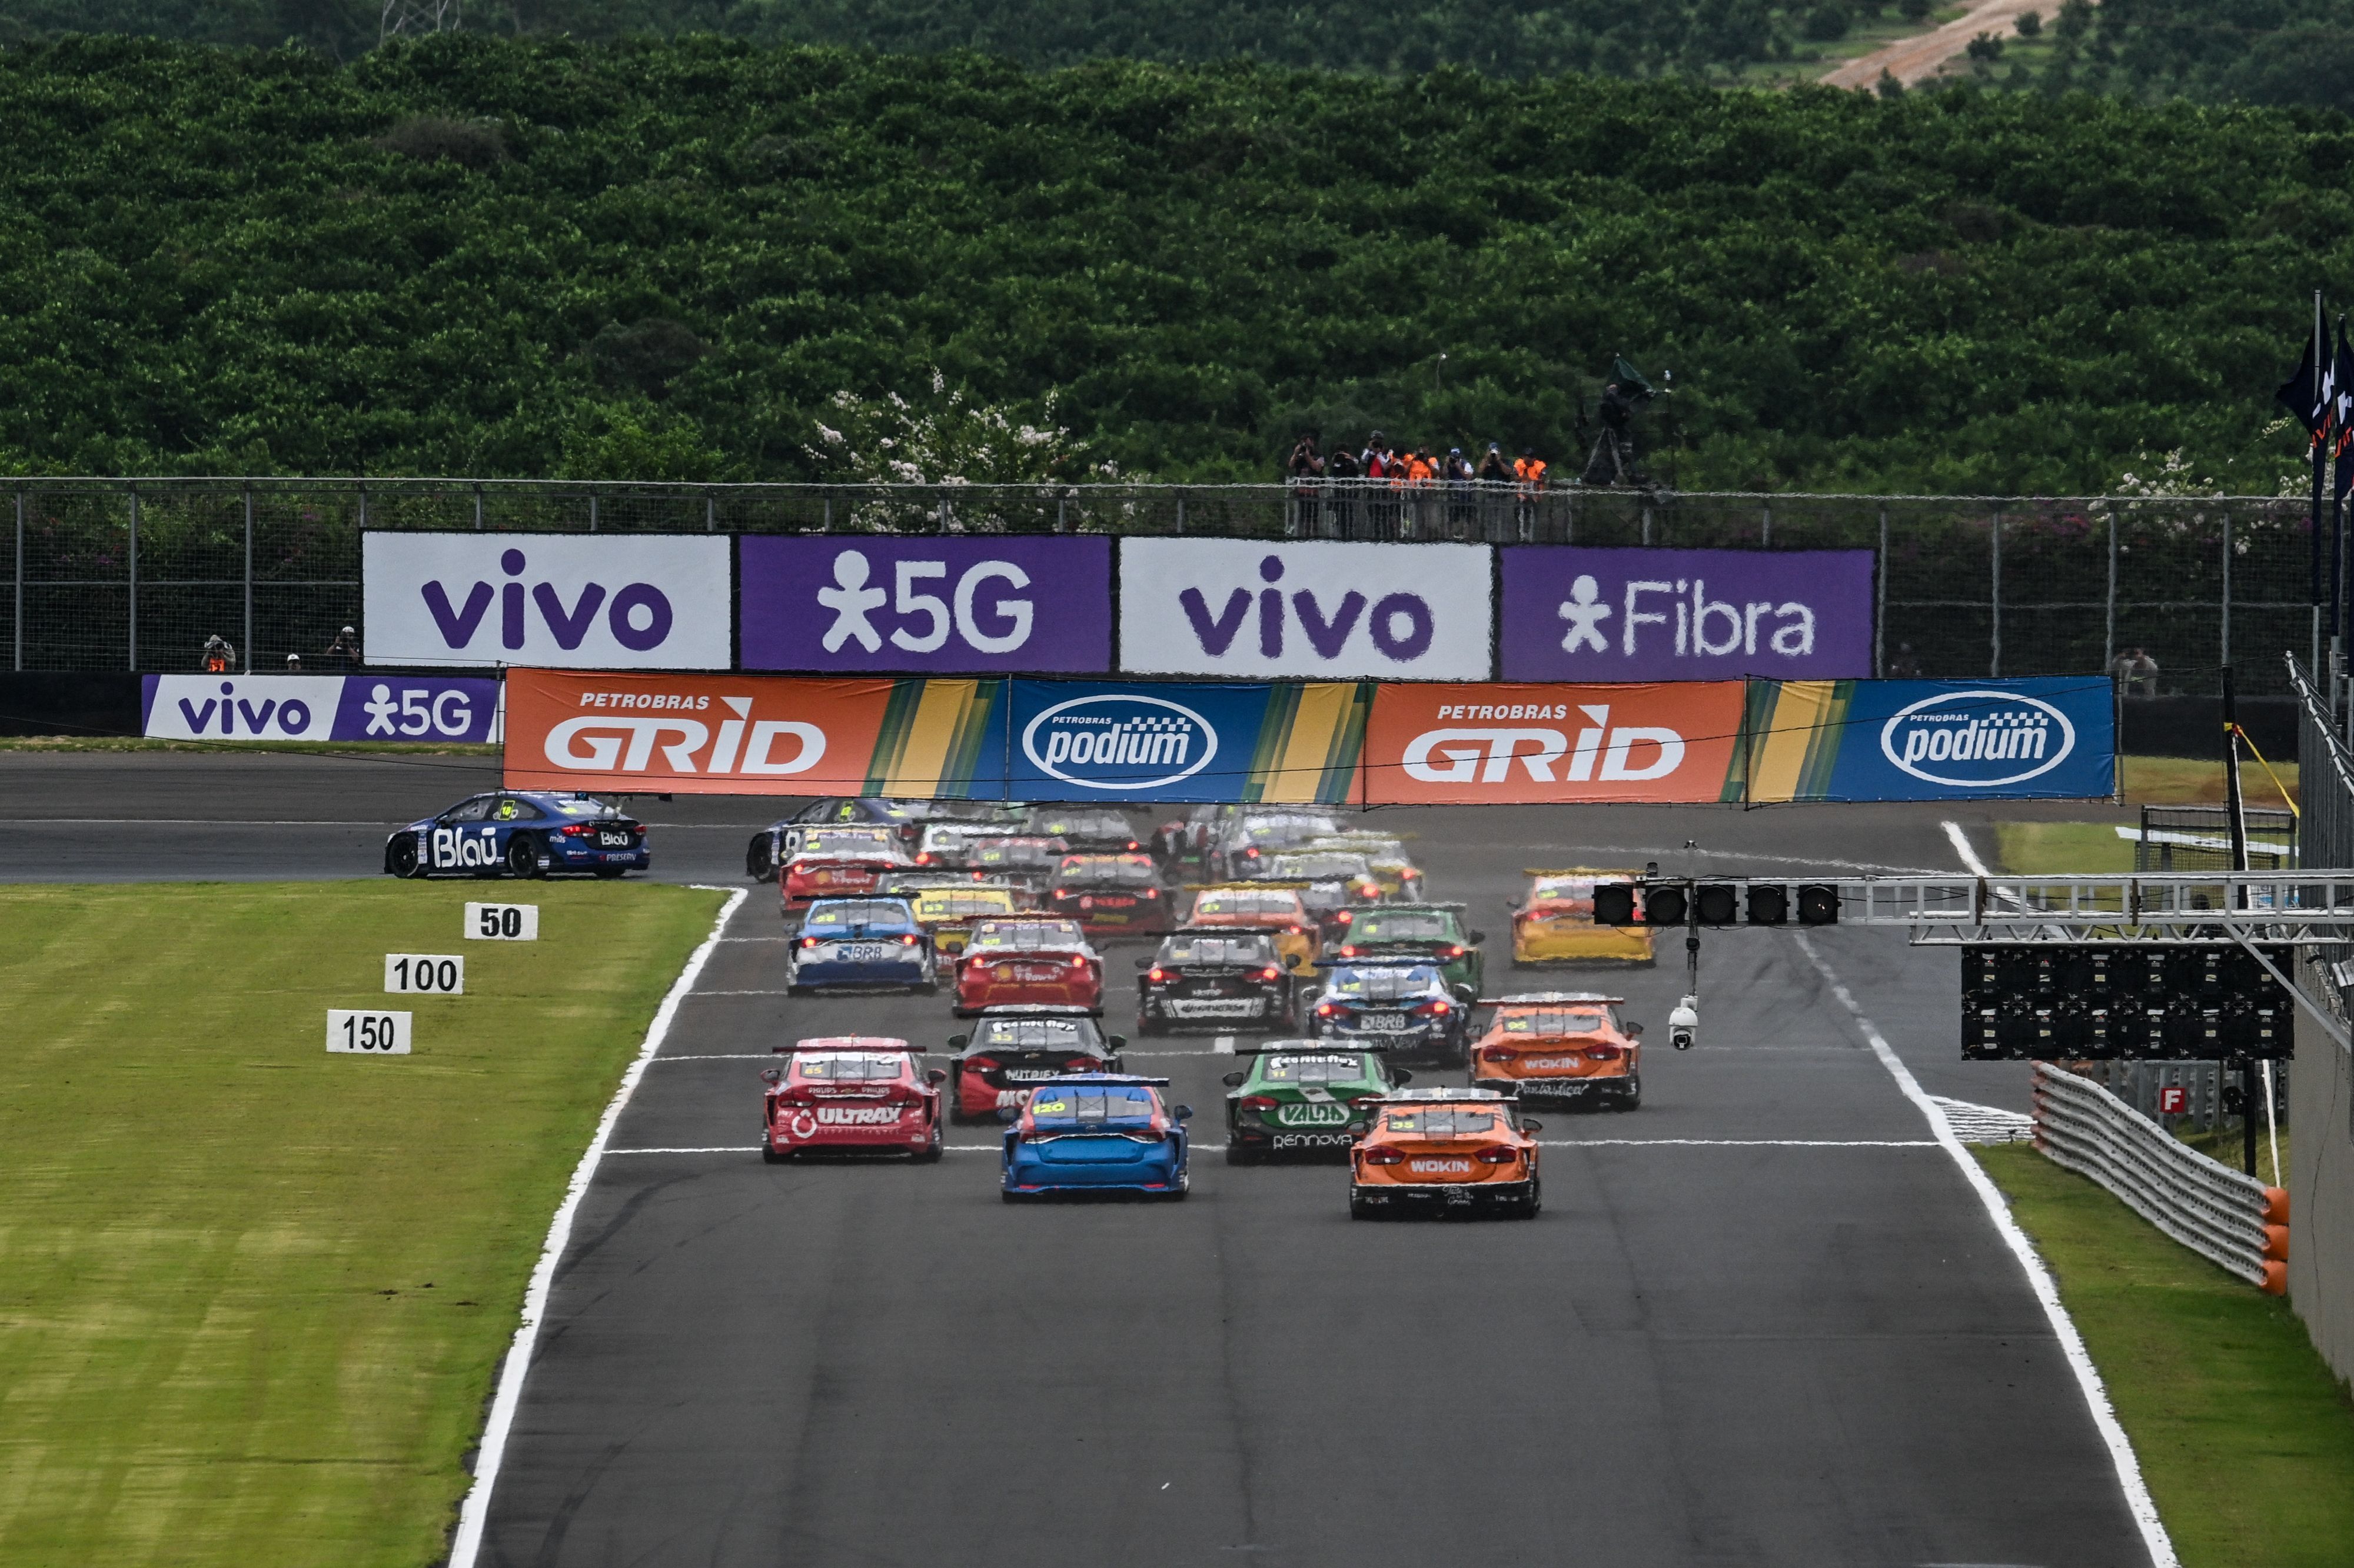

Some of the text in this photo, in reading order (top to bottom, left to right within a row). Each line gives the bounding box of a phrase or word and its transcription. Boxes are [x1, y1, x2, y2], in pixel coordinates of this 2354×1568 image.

[421, 548, 673, 651] vivo
[890, 560, 1033, 653] 5G
[1179, 555, 1434, 663] vivo
[1623, 579, 1815, 656] Fibra
[178, 681, 311, 734] vivo
[399, 690, 471, 735] 5G
[580, 693, 709, 710] PETROBRAS
[1437, 705, 1567, 720] PETROBRAS
[1909, 714, 1969, 722] PETROBRAS
[544, 697, 826, 774] GRID
[1052, 716, 1112, 724] PETROBRAS
[1045, 717, 1191, 768] podium
[1402, 705, 1685, 783] GRID
[1904, 713, 2048, 767] podium
[481, 908, 521, 937] 50
[394, 958, 457, 991] 100
[344, 1016, 394, 1050] 150
[1525, 1058, 1579, 1069] WOKIN
[817, 1107, 904, 1124] ULTRAX
[1033, 1103, 1065, 1114] 120
[2165, 1090, 2181, 1110] F
[1411, 1160, 1469, 1173] WOKIN
